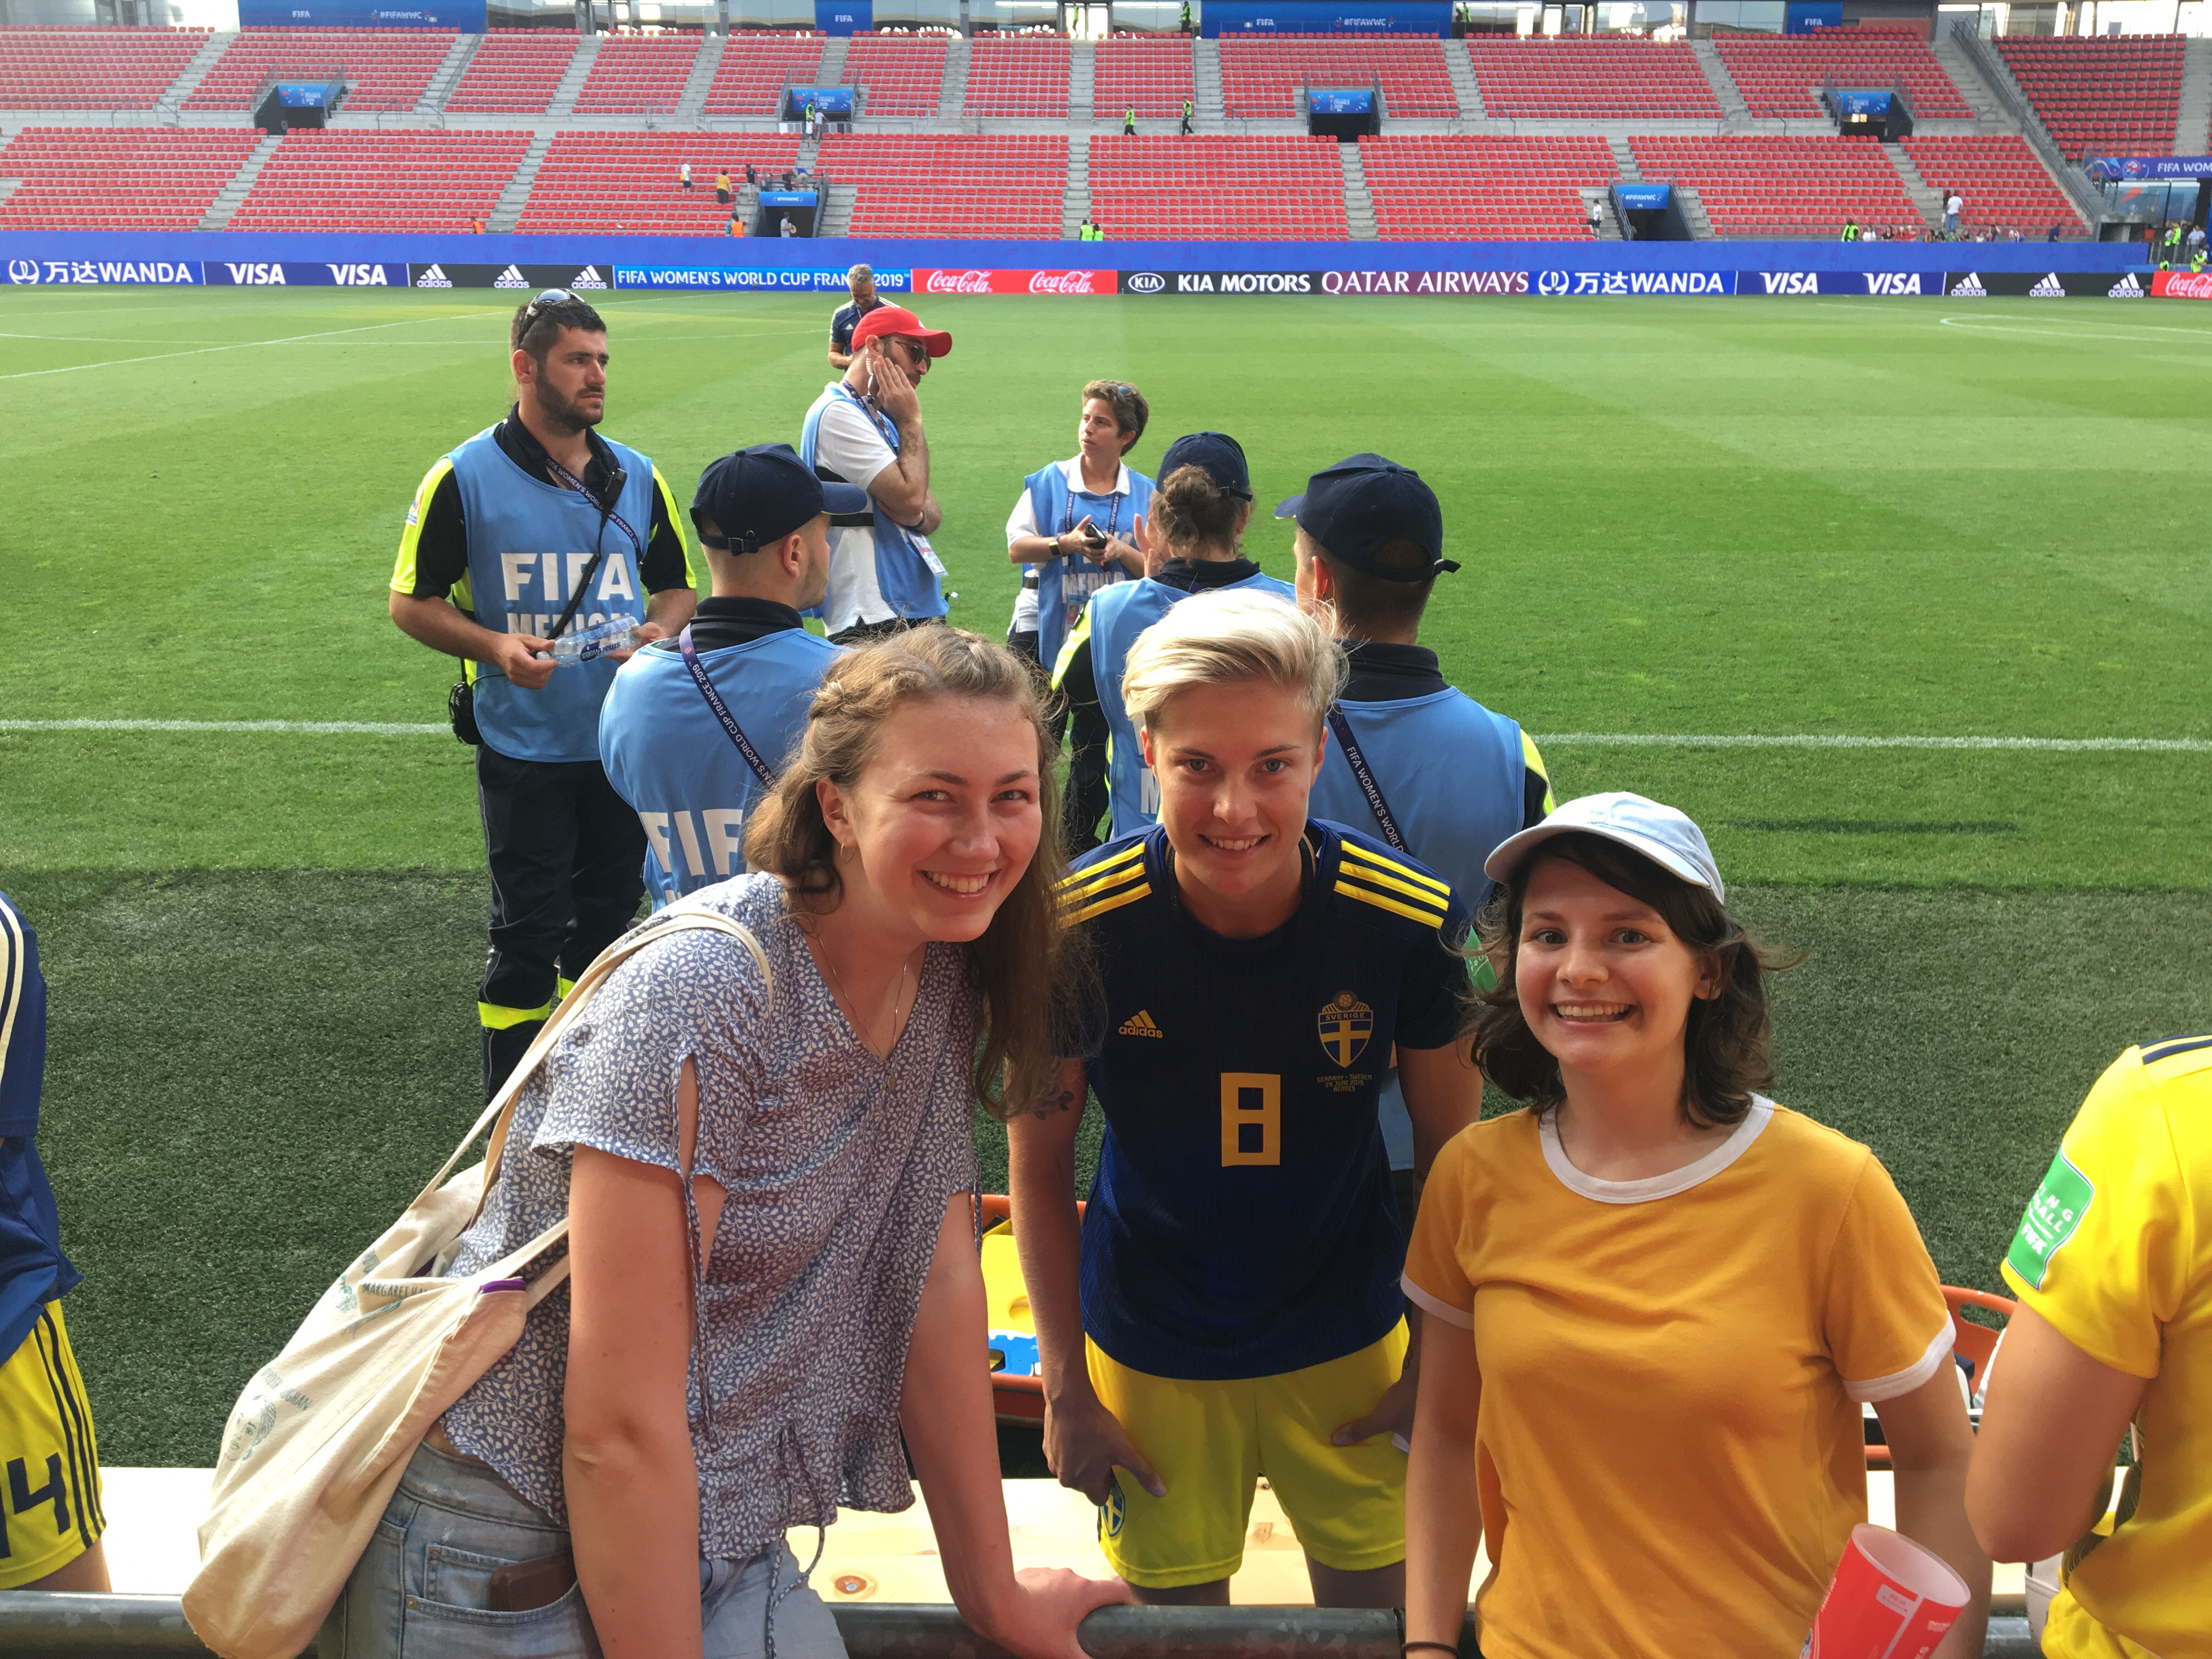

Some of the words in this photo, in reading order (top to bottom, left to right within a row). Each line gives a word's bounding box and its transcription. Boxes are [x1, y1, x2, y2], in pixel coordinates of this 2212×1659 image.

[292, 10, 311, 19] FIFA
[380, 11, 422, 20] #FIFAWWC
[2158, 162, 2180, 172] FIFA
[43, 261, 98, 284] 万达
[99, 262, 193, 284] WANDA
[224, 263, 286, 285] VISA
[326, 264, 387, 285] VISA
[618, 270, 647, 284] FIFA
[651, 271, 720, 285] WOMEN'S
[724, 272, 777, 286] WORLD
[780, 272, 810, 286] CUP
[814, 273, 849, 286] FRAN
[927, 270, 992, 293] Coca-Cola
[1029, 270, 1094, 294] Coca-Cola
[1135, 276, 1158, 289] KIA
[1178, 274, 1215, 292] KIA
[1221, 274, 1311, 292] MOTORS
[1322, 271, 1410, 295] QATAR
[1417, 271, 1529, 293] AIRWAYS
[1574, 272, 1628, 294] 万达
[1632, 273, 1724, 293] WANDA
[417, 279, 453, 288] adidas
[494, 279, 530, 289] adidas
[572, 280, 607, 290] adidas
[1759, 273, 1818, 294] VISA
[1863, 273, 1921, 295] VISA
[1951, 287, 1987, 297] adidas
[2029, 287, 2066, 297] adidas
[2108, 288, 2145, 297] adidas
[545, 459, 557, 470] FIFA
[558, 468, 585, 493] WOMEN'S
[616, 518, 634, 538] FRANCE
[501, 553, 634, 601] FIFA
[507, 612, 630, 640] MEDIC
[582, 642, 621, 659] smartwater
[702, 682, 726, 716] FRANCE
[723, 716, 738, 735] CUP
[735, 734, 759, 767] WORLD
[1347, 746, 1362, 768] FIFA
[1358, 768, 1386, 817] WOMEN'S
[1381, 816, 1404, 852] WORLD
[642, 809, 760, 876] FIF
[1325, 1012, 1365, 1021] SVERIGE
[1119, 1025, 1163, 1039] adidas
[1220, 1072, 1281, 1167] 8
[2021, 1222, 2048, 1255] FIFA
[362, 1282, 409, 1298] MARGARET
